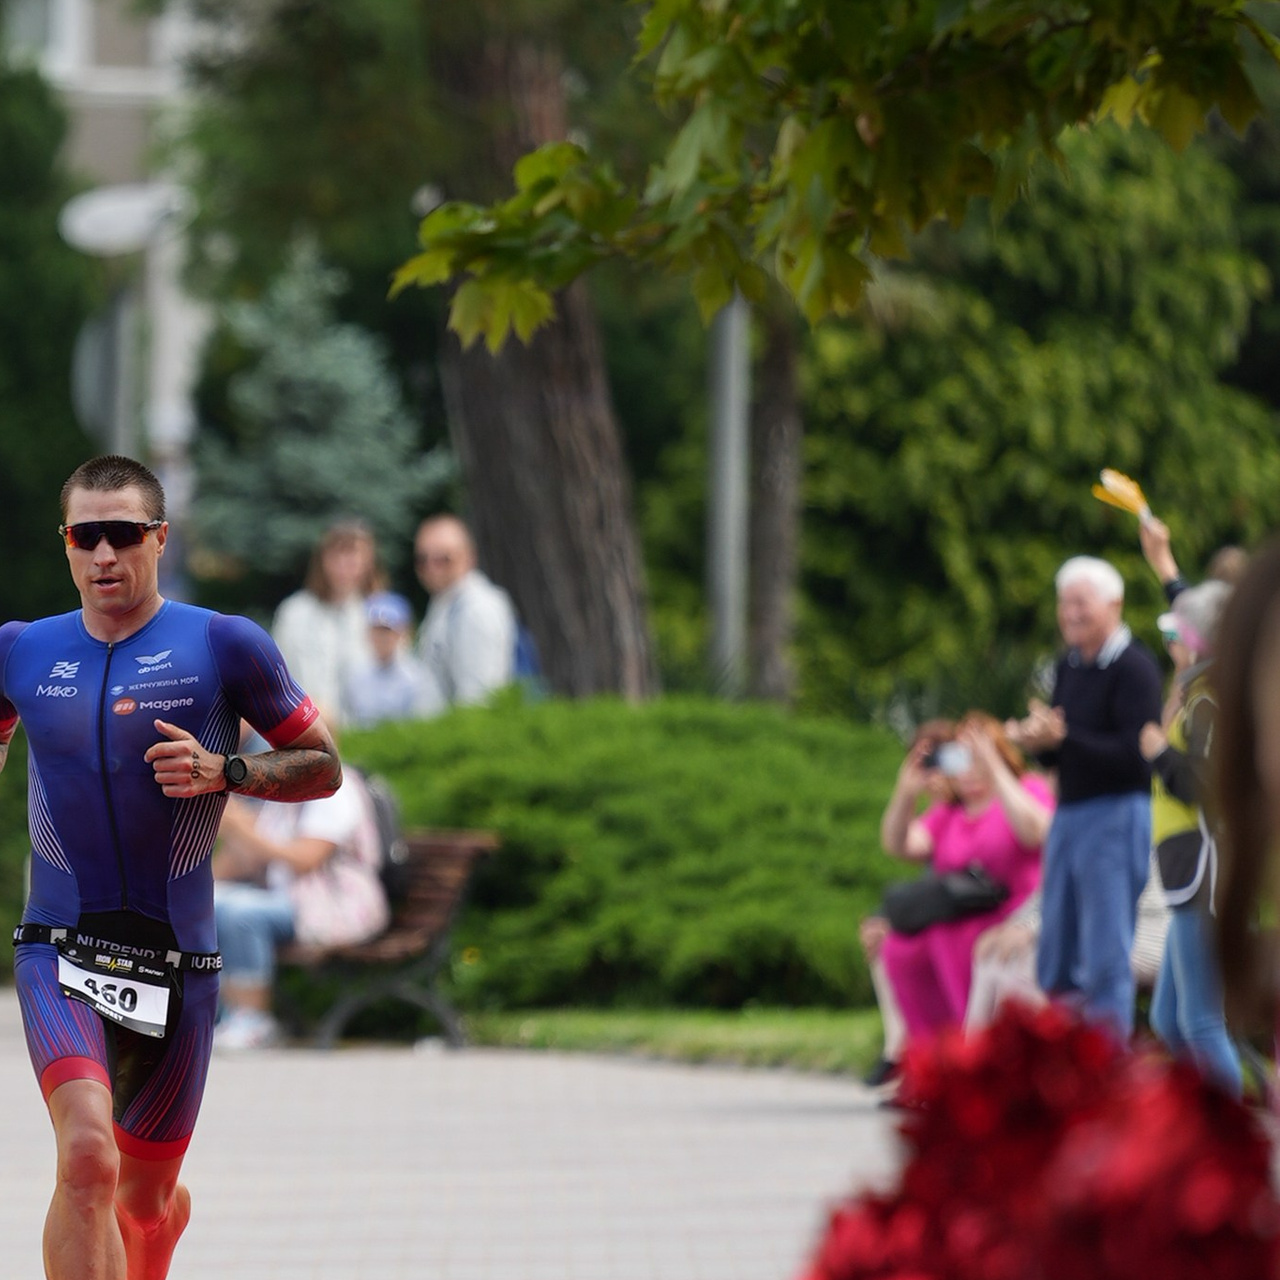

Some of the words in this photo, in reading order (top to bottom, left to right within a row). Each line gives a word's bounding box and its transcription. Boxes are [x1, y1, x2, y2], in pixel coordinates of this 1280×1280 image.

[140, 697, 194, 711] Magene
[191, 751, 200, 779] 460
[84, 978, 138, 1013] 460
[95, 1003, 124, 1022] ANDREY
